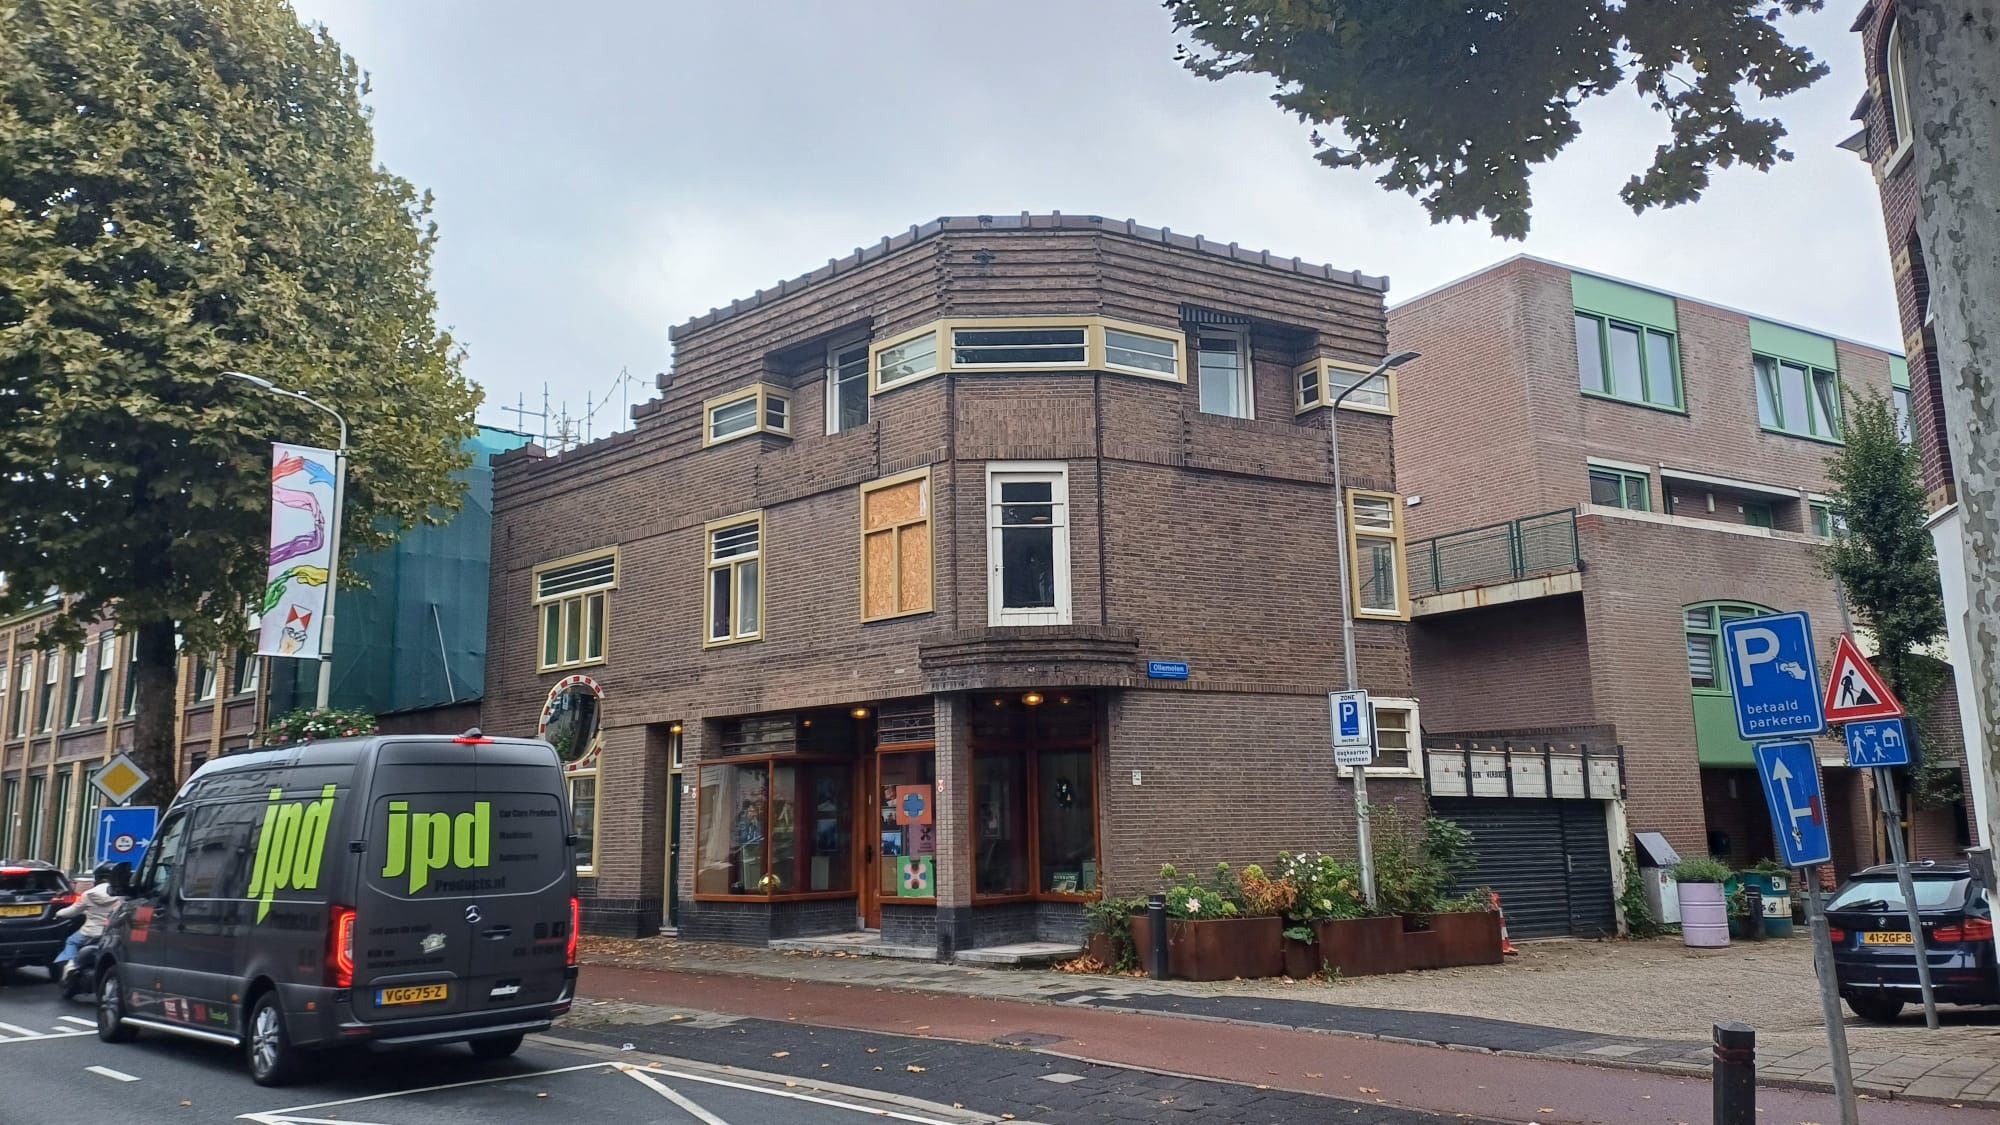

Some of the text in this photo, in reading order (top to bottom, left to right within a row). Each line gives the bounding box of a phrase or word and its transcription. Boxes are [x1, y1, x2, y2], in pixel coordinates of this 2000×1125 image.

[1734, 627, 1780, 687] P
[1342, 703, 1354, 722] P
[1746, 699, 1798, 714] betaald
[1750, 715, 1811, 730] parkeren
[248, 784, 336, 925] jpd
[382, 801, 490, 895] jpd
[1868, 932, 1912, 943] 41-ZGF-8
[385, 985, 442, 1002] VGG-75-Z
